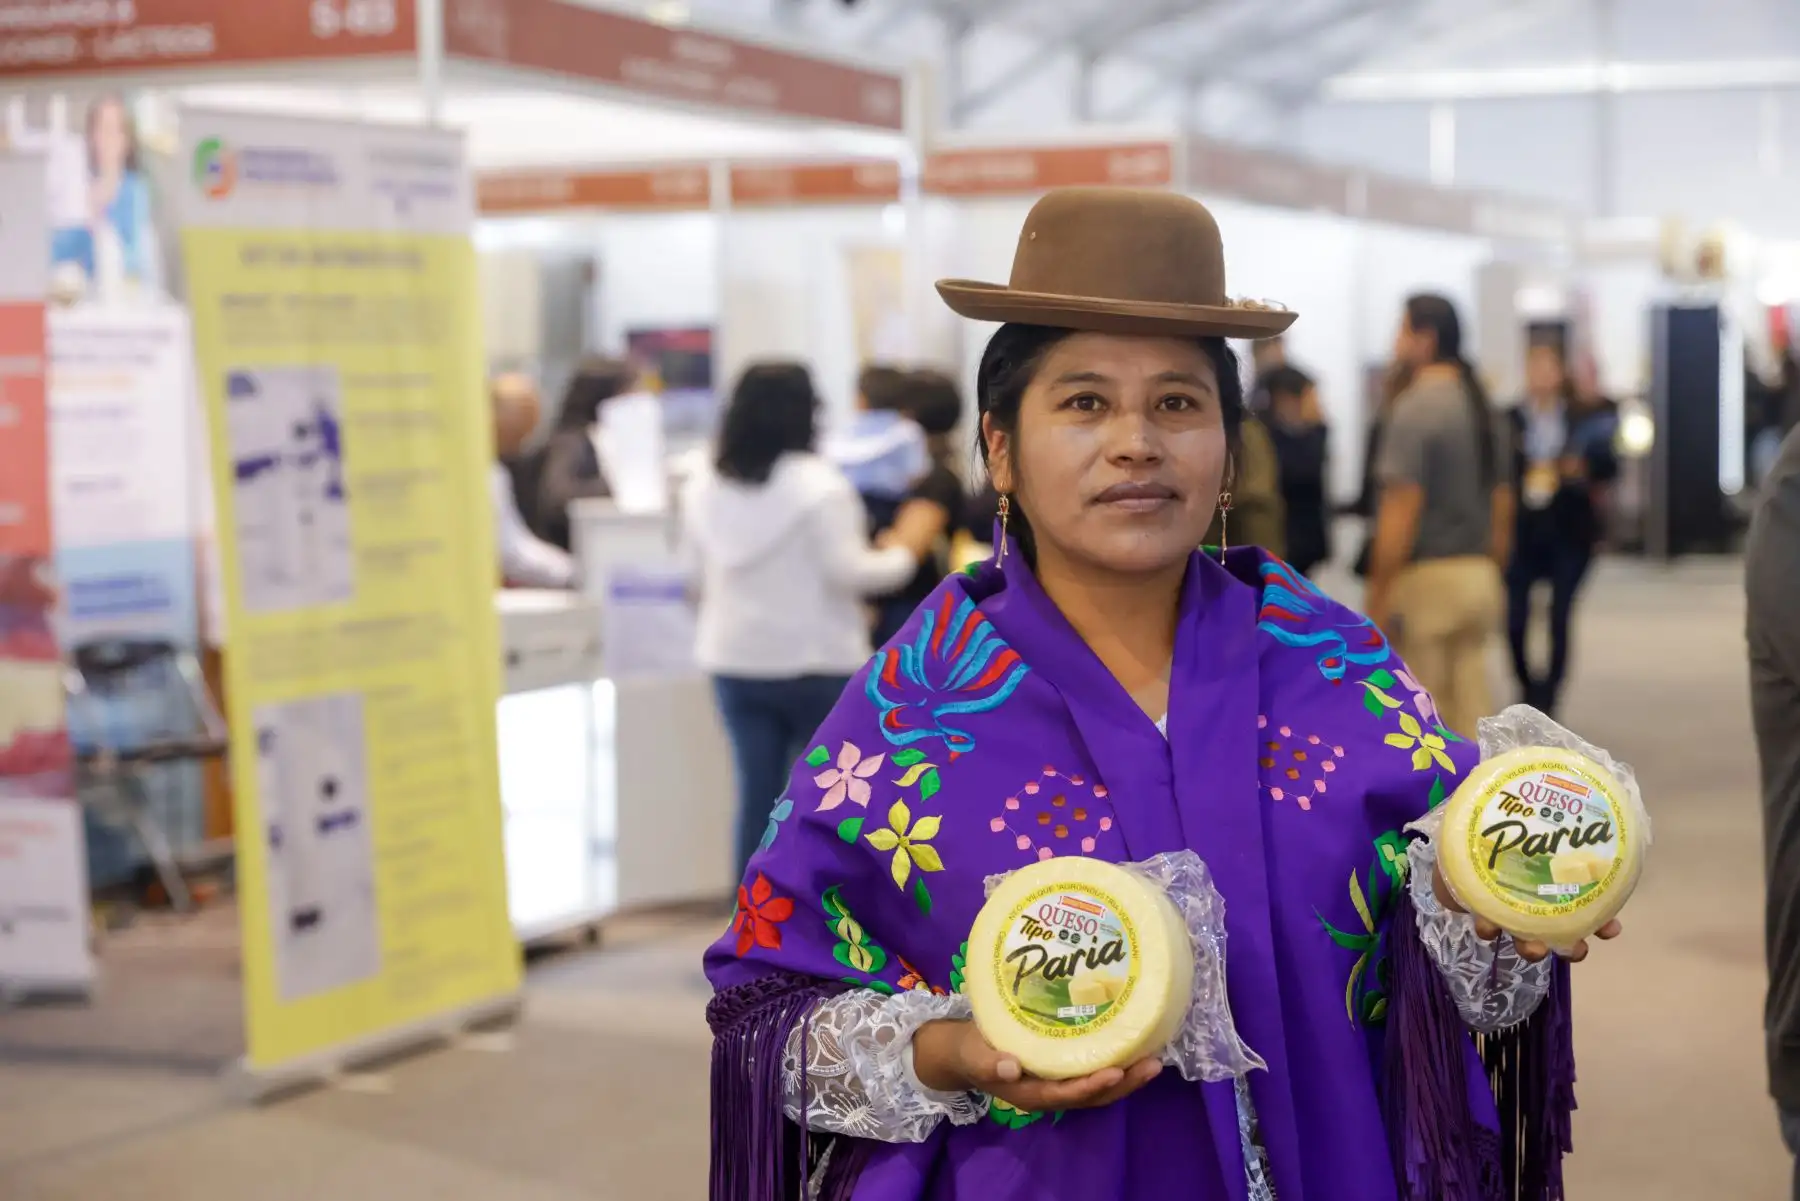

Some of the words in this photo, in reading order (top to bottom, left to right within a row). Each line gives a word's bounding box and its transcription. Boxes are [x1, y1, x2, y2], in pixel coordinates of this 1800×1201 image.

[1498, 791, 1535, 818] Tipo
[1519, 781, 1583, 816] QUESO
[1481, 816, 1613, 870] Paria
[1020, 914, 1054, 941] Tipo
[1038, 903, 1098, 936] QUESO
[1006, 936, 1127, 996] Paria
